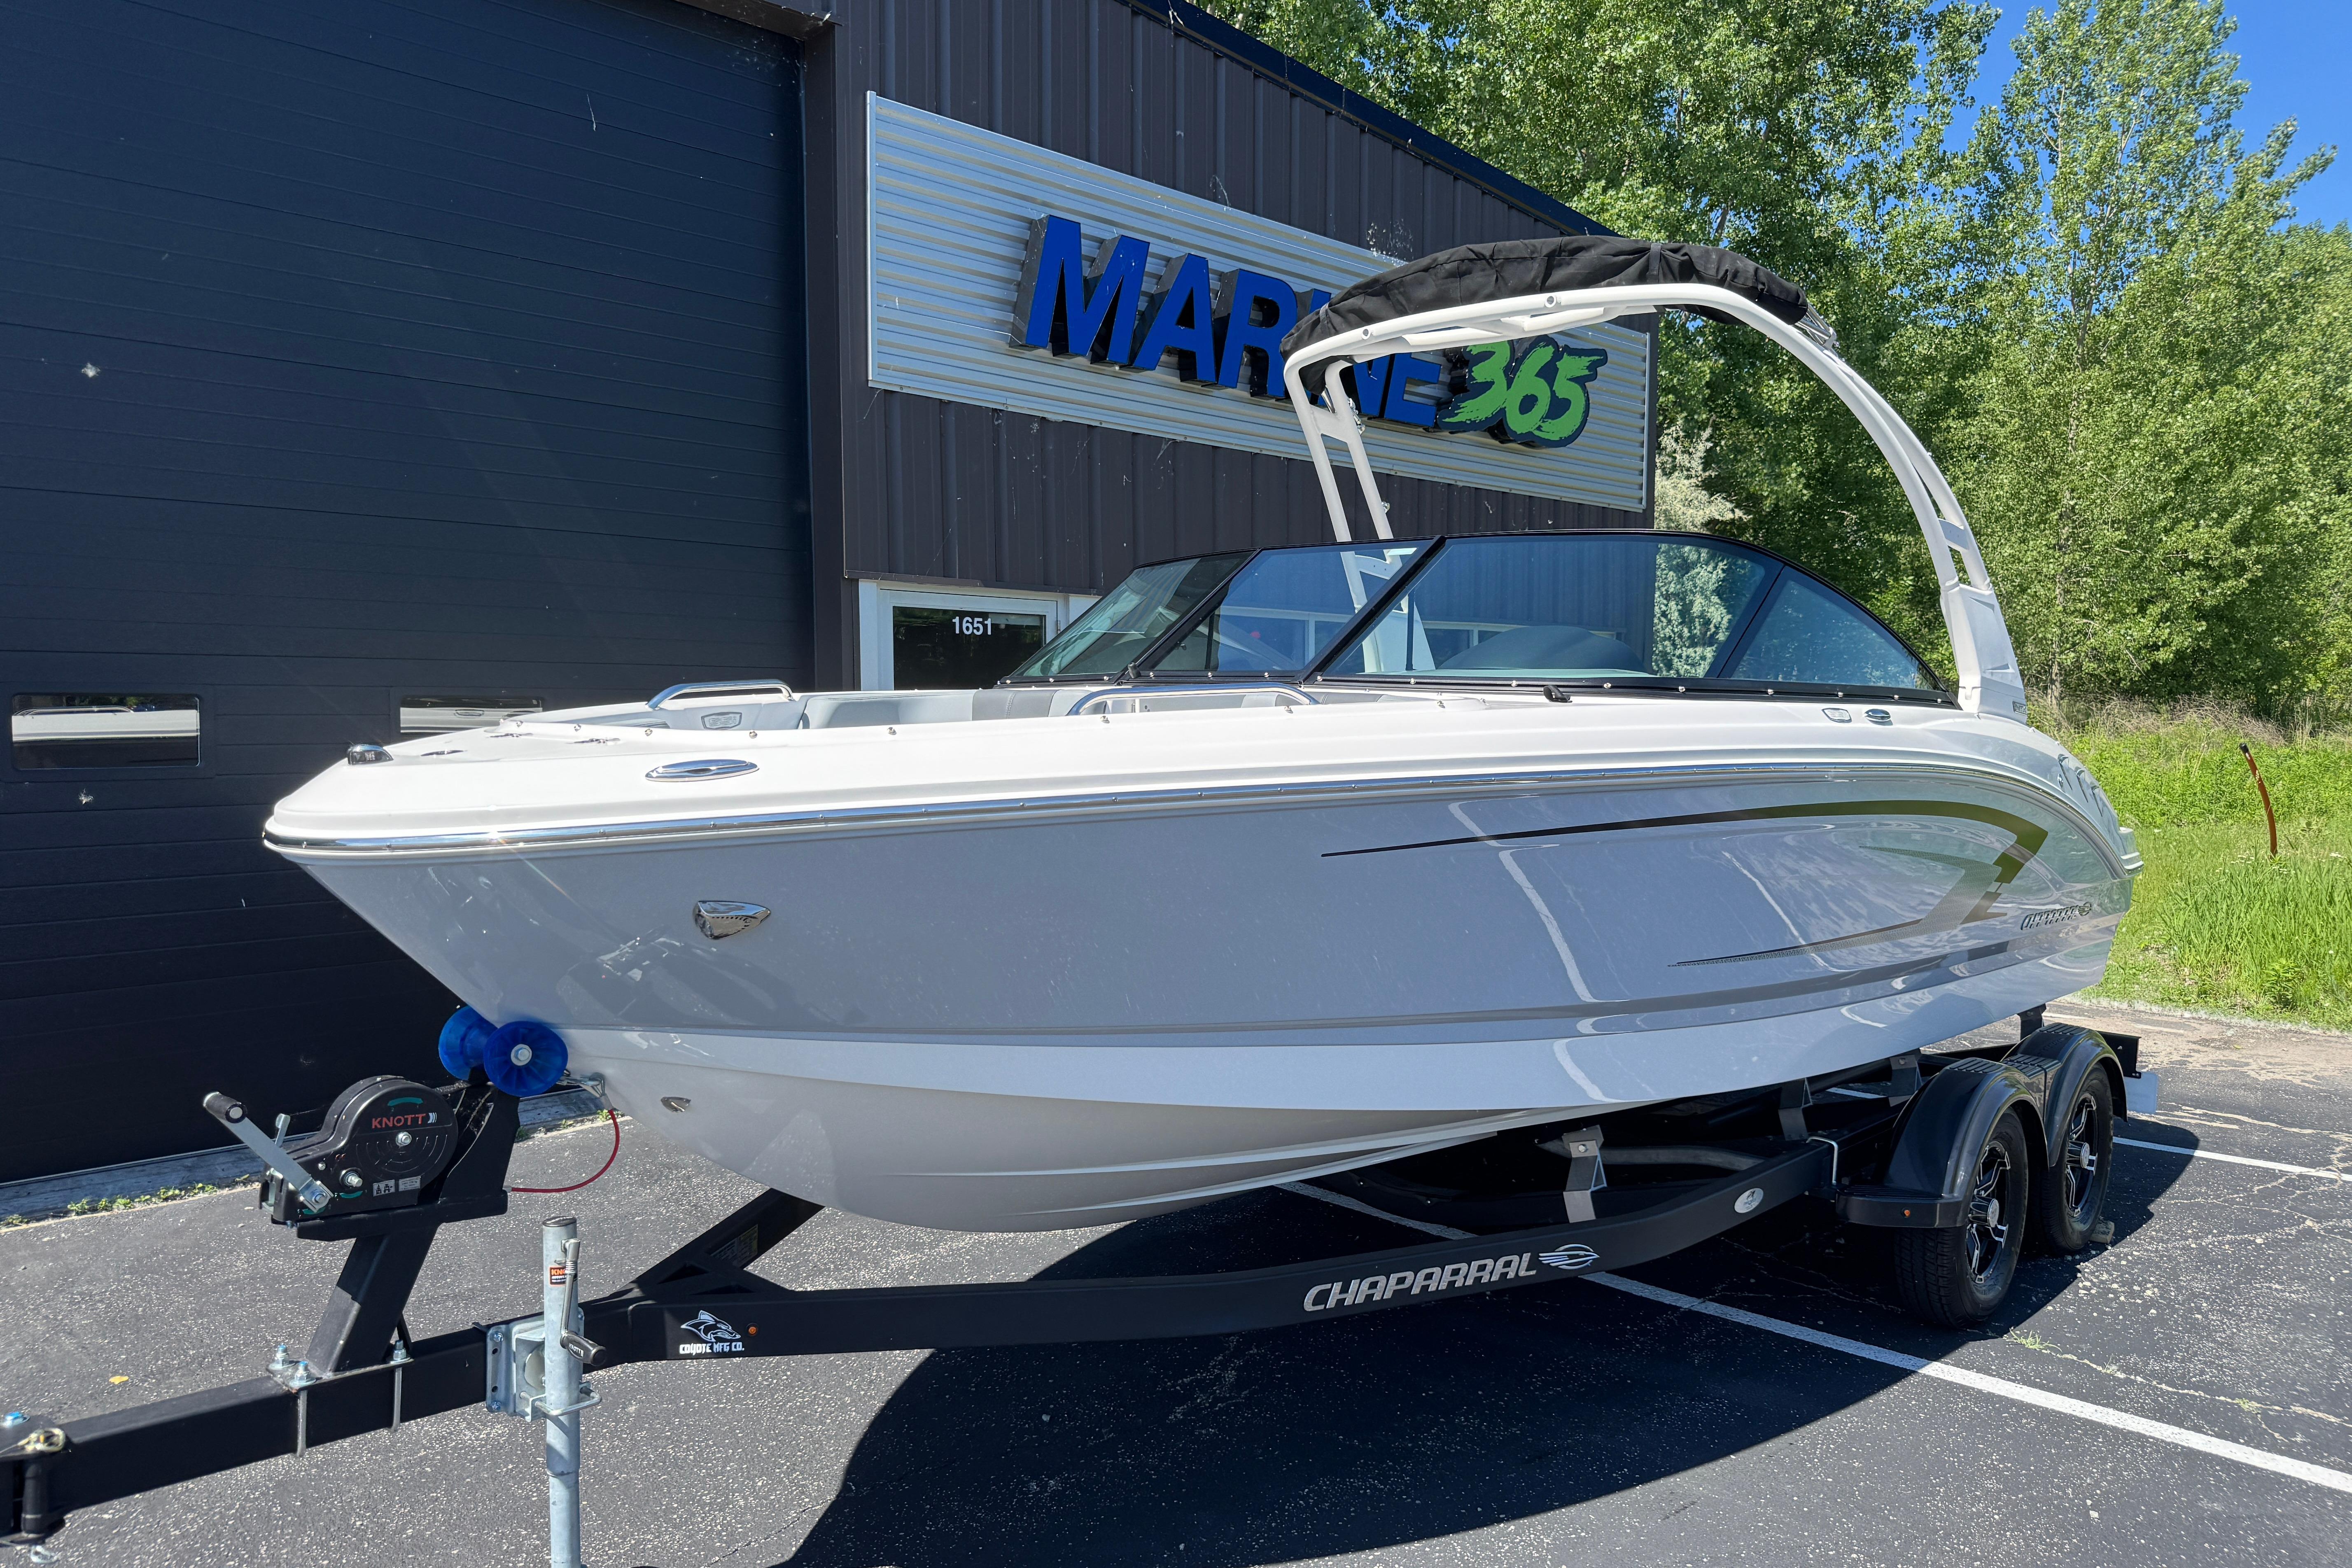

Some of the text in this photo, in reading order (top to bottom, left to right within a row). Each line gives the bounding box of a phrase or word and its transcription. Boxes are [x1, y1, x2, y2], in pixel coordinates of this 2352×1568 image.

[1025, 215, 1606, 445] MARE 365
[952, 616, 991, 635] 1651
[372, 1113, 426, 1129] KNOTT
[1304, 1253, 1537, 1311] CHAPARRAL
[679, 1342, 744, 1355] COYOTE MFG CO.
